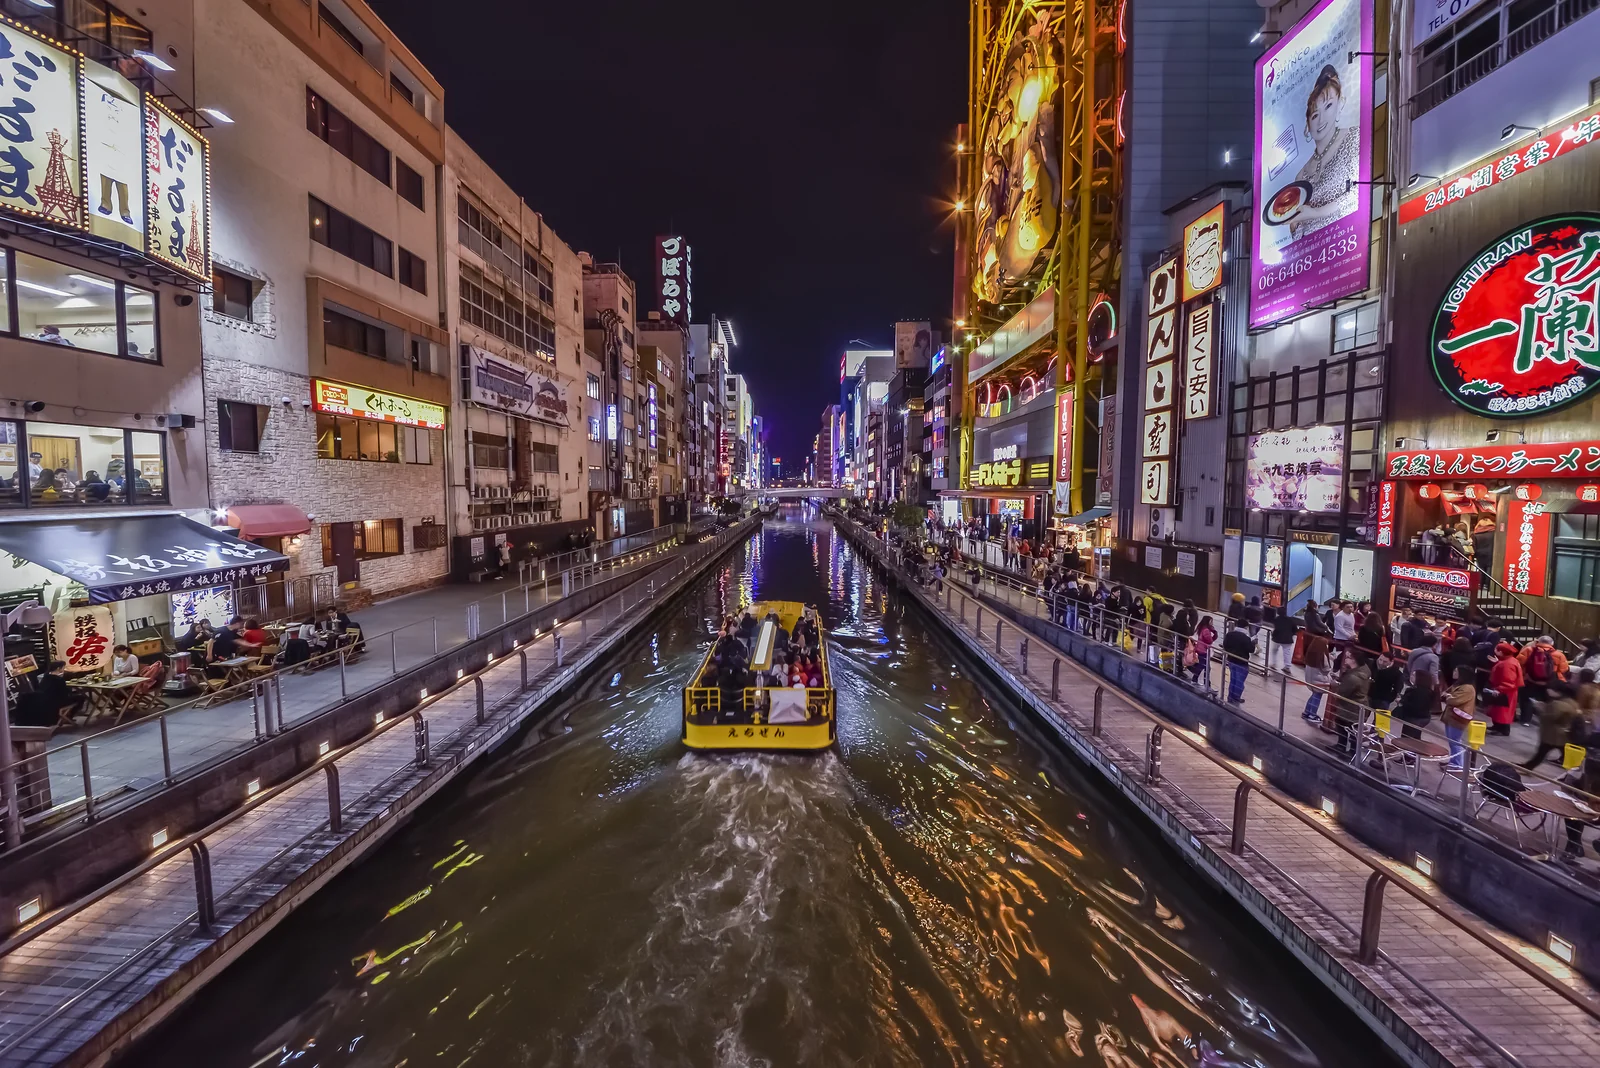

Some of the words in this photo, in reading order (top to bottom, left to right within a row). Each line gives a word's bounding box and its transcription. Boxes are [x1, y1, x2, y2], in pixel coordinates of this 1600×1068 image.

[160, 127, 194, 264] だるま
[1258, 234, 1358, 290] 06-6468-4538
[1443, 229, 1532, 312] ICHIRAN
[1438, 231, 1600, 374] 一蘭
[1186, 309, 1210, 416] 旨くて安い
[365, 393, 412, 417] くれおーる
[120, 582, 171, 599] 鉄板焼
[1391, 565, 1447, 583] お土産販売所
